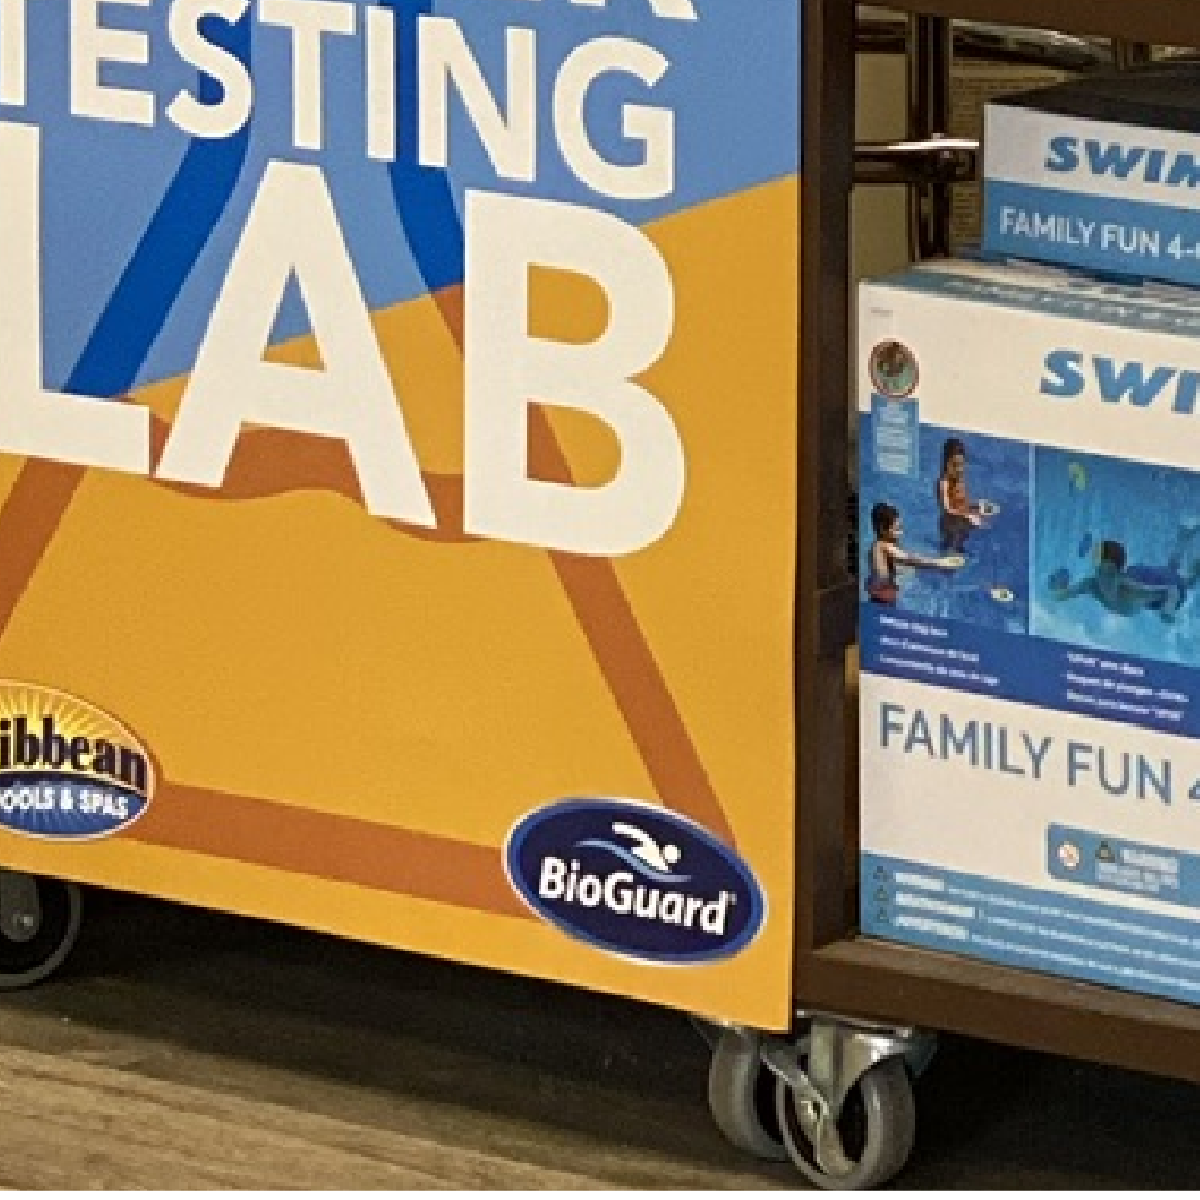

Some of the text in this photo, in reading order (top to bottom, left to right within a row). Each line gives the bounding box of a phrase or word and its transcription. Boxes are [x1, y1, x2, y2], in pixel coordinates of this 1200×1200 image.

[999, 205, 1200, 260] FAMILY FUN 4-
[879, 702, 1052, 779] FAMILY
[1066, 739, 1171, 806] FUN
[79, 789, 130, 820] SPAS
[539, 856, 729, 936] BioGuard
